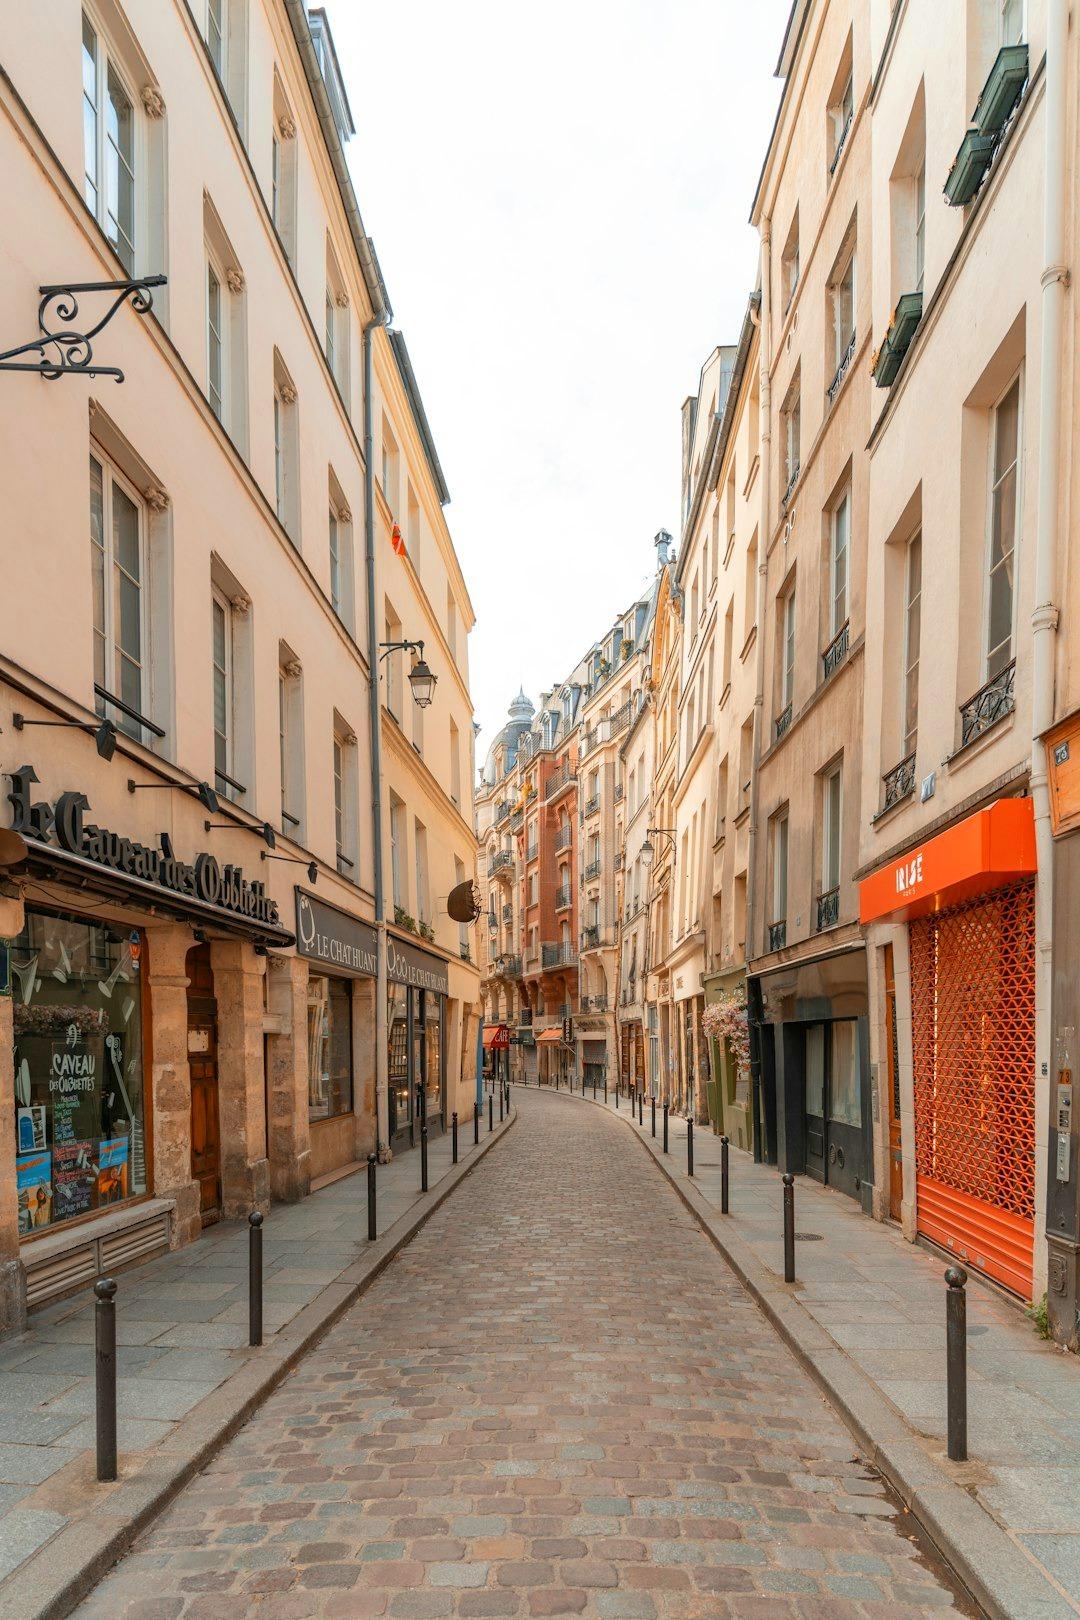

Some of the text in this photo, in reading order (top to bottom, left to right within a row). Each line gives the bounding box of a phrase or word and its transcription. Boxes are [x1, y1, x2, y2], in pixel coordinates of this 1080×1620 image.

[7, 765, 280, 924] Le Caveau des Oubliettes
[316, 933, 377, 973] LE CHAT HUANT
[408, 965, 447, 991] LE CHAT HUANT
[53, 1053, 96, 1076] CAVEAU
[1059, 1070, 1070, 1083] 73
[49, 1075, 95, 1093] DES OUBLIETTES
